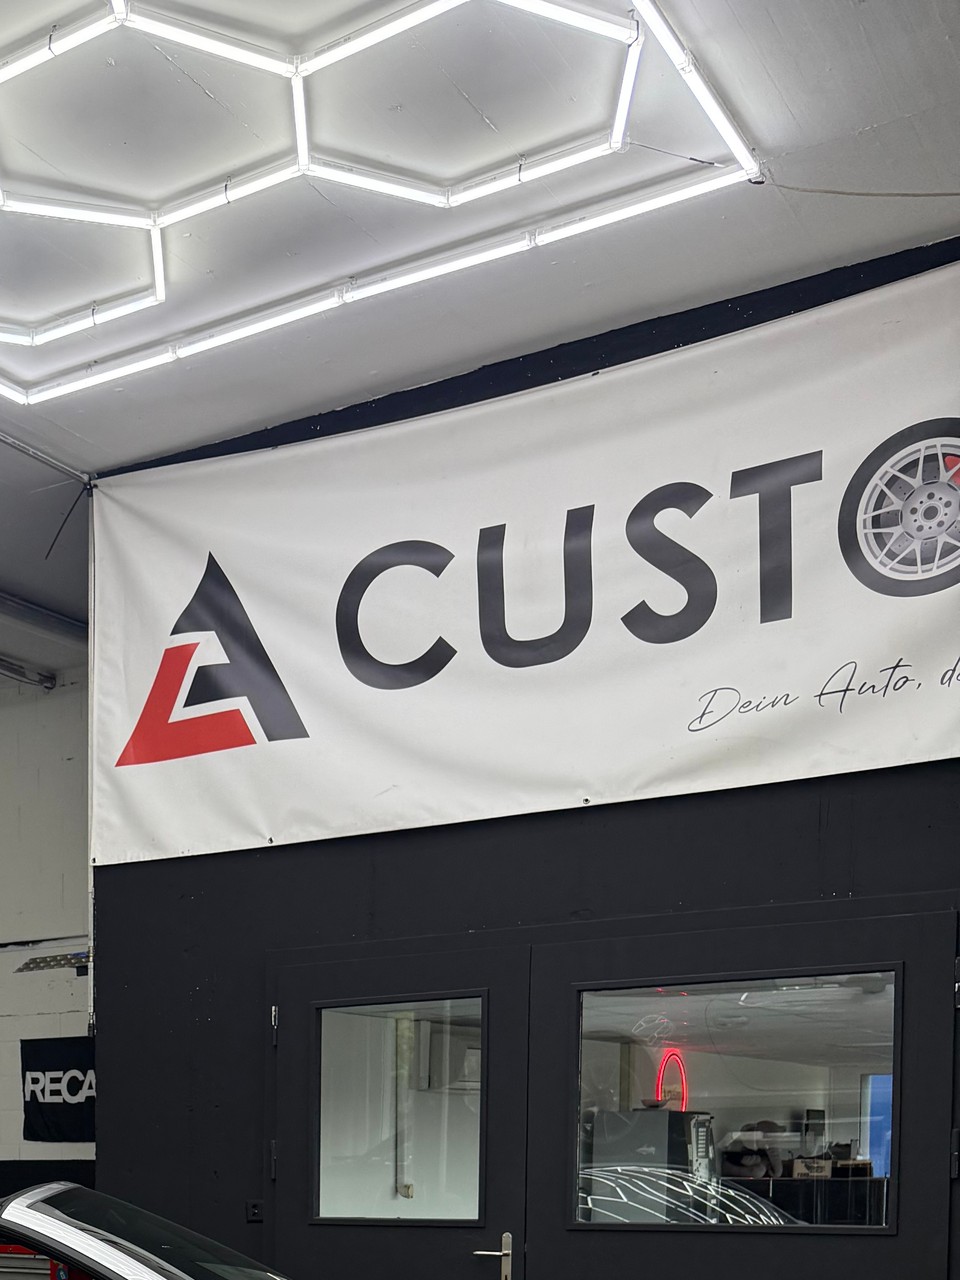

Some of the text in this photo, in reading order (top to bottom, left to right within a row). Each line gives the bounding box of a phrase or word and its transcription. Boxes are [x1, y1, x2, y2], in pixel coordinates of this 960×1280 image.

[688, 687, 800, 732] Dein
[813, 657, 922, 714] Auto,
[24, 1069, 97, 1104] RECA
